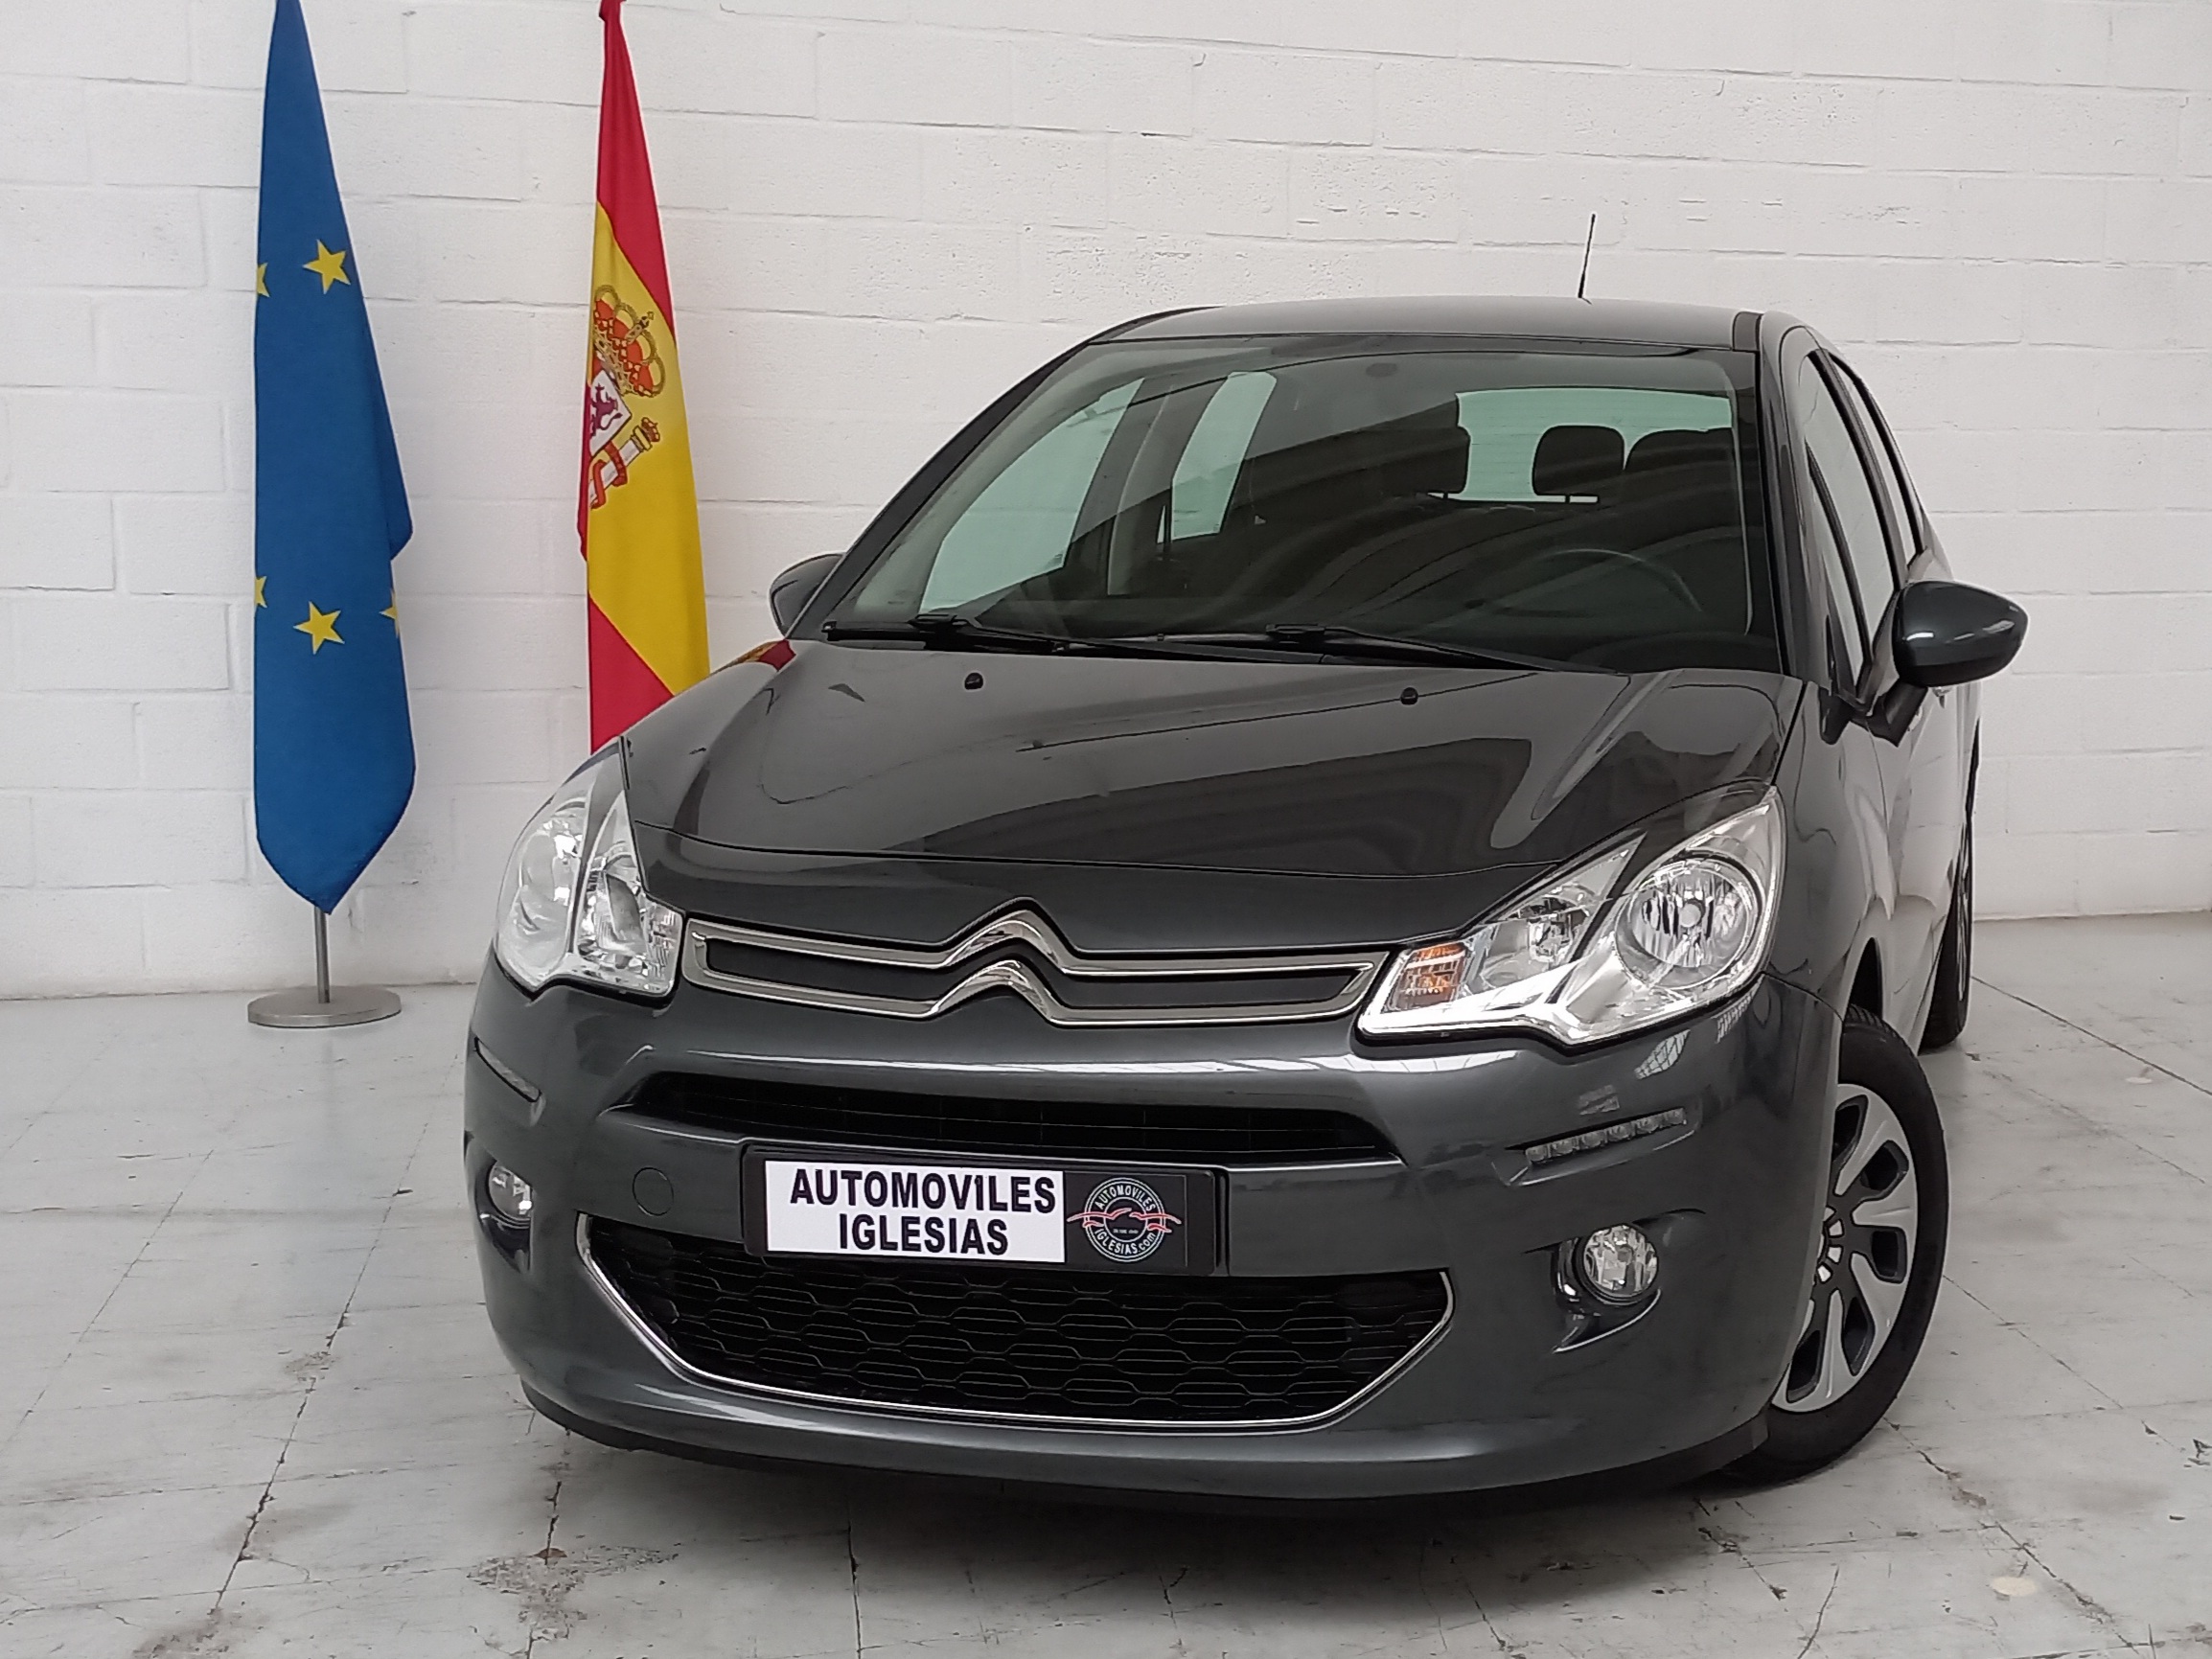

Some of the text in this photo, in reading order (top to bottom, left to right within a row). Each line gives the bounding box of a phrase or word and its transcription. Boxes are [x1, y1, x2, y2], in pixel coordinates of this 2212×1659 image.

[790, 1167, 1055, 1213] AUTOMOVILES
[1094, 1185, 1156, 1210] AUTOMOVILES
[839, 1212, 1008, 1256] IGLESIAS
[1094, 1229, 1156, 1255] IGLESIAS.com
